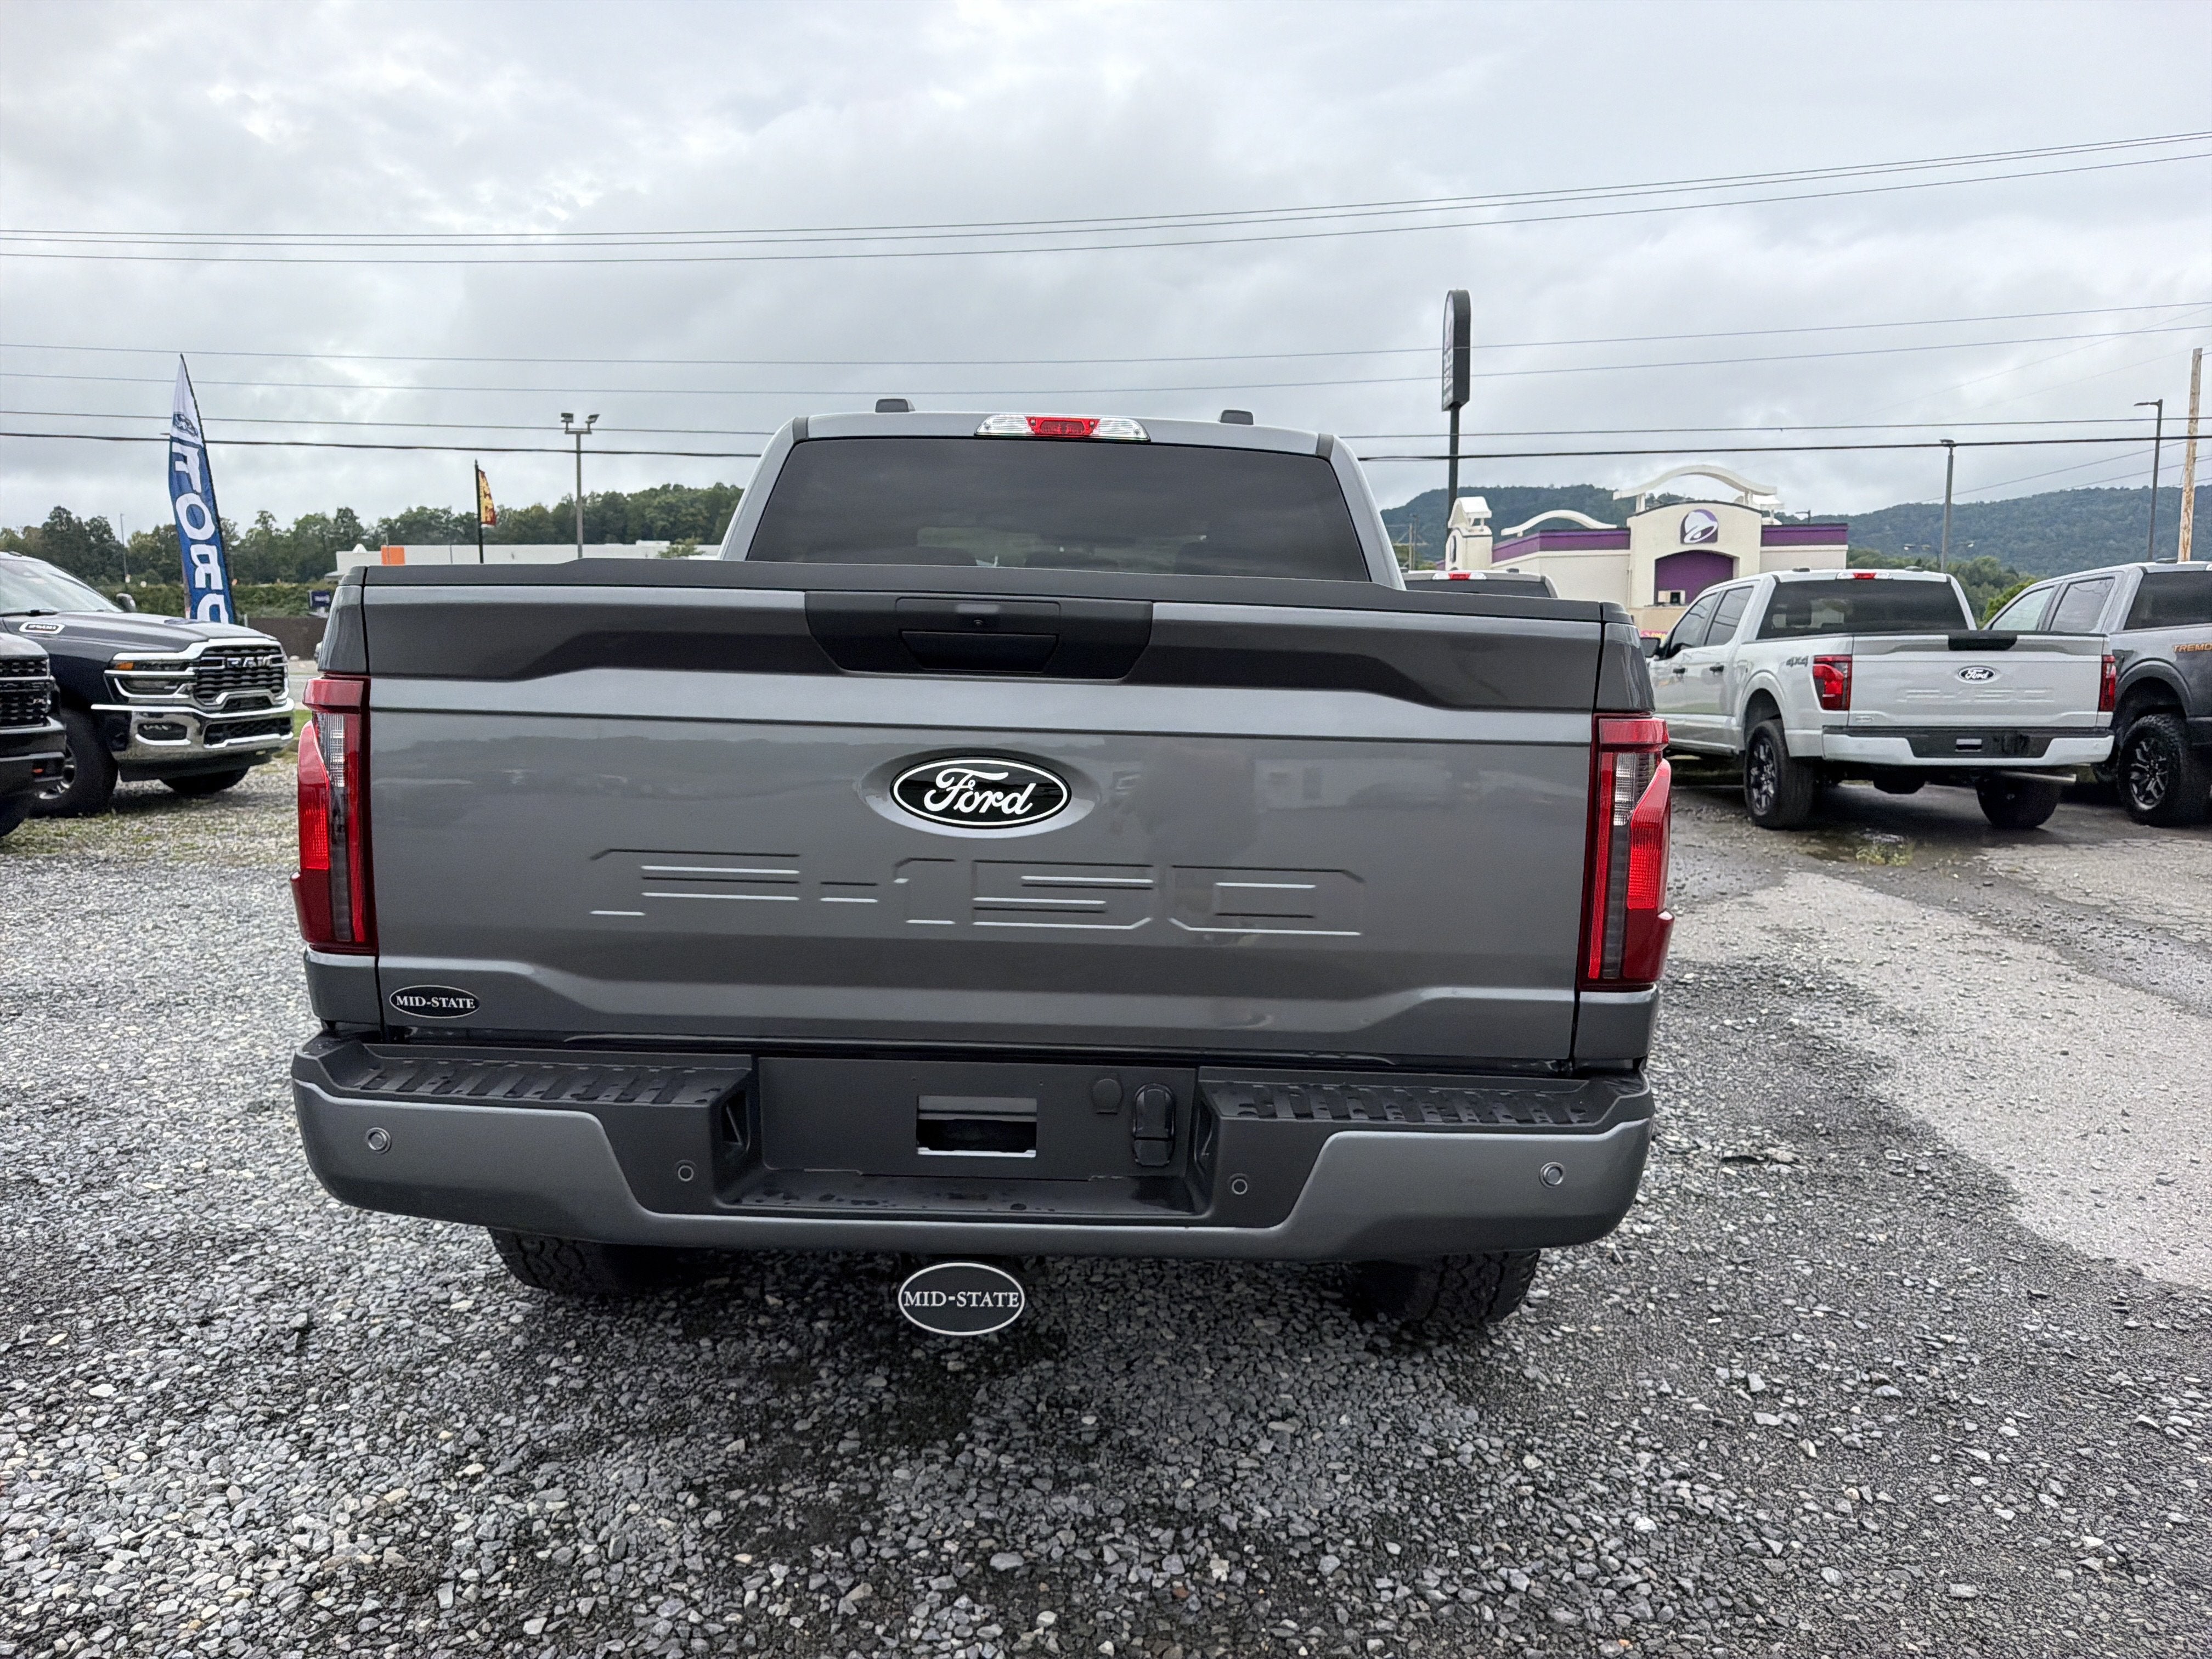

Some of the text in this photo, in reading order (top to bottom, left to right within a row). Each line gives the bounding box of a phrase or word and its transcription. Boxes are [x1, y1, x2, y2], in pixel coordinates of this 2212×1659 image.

[227, 656, 272, 668] RAM
[1965, 669, 1989, 679] Ford
[924, 768, 1036, 815] Ford
[396, 995, 476, 1009] MID-STATE
[904, 1291, 1019, 1308] MID-STATE
